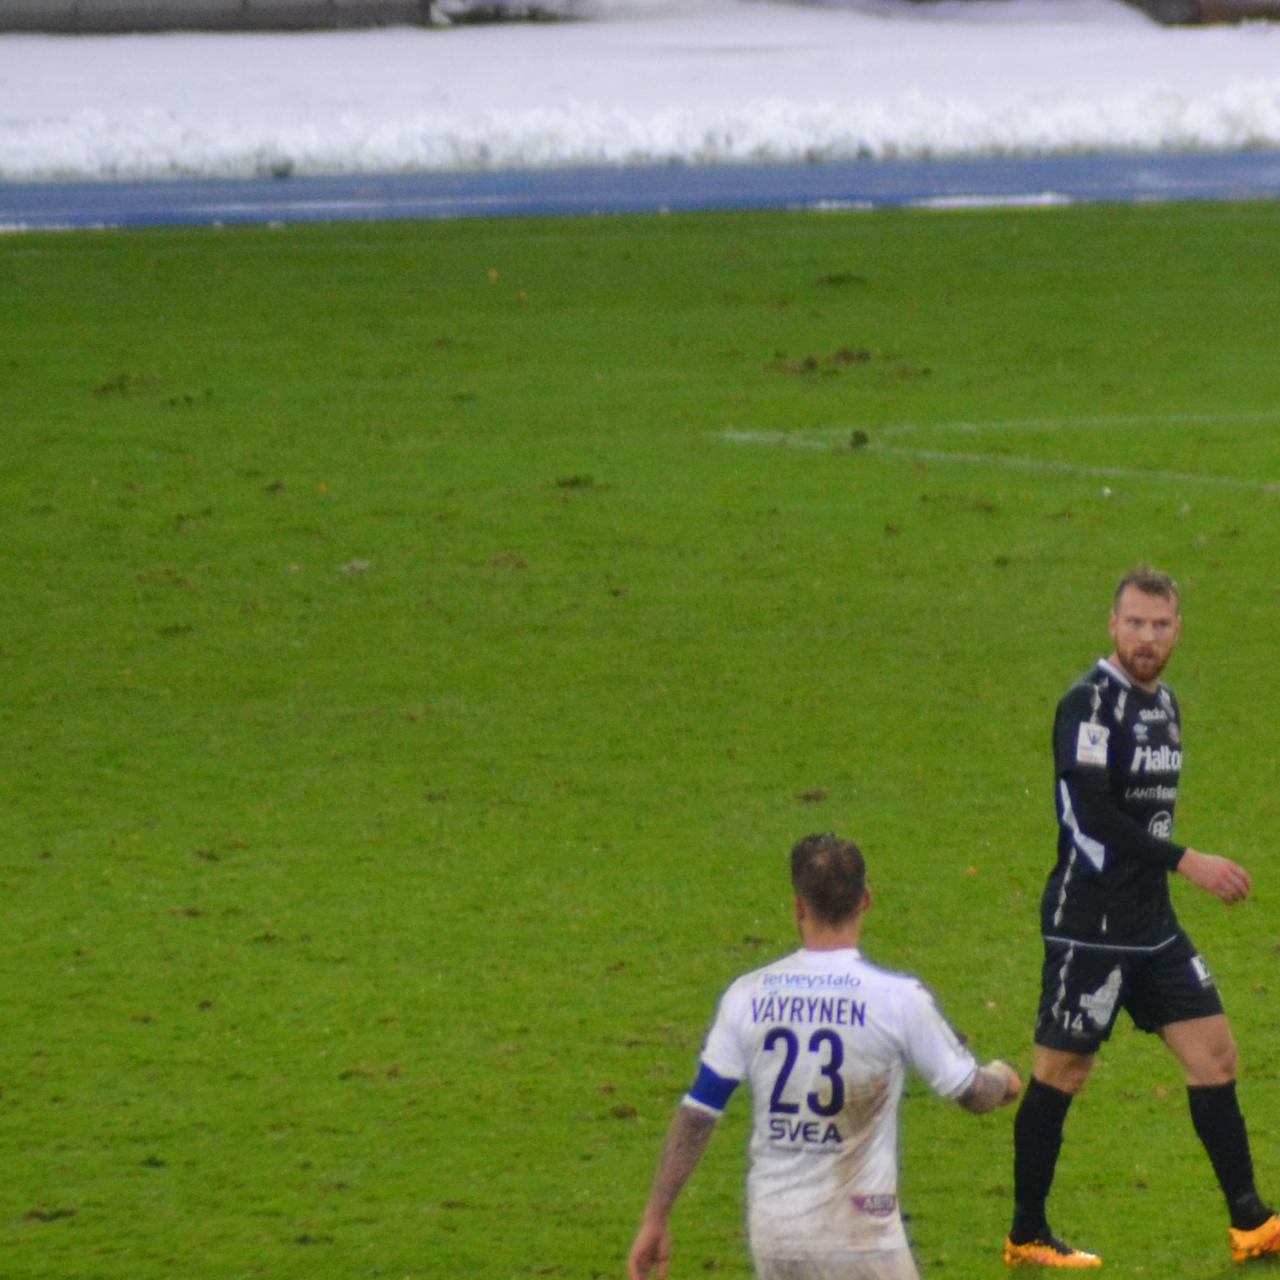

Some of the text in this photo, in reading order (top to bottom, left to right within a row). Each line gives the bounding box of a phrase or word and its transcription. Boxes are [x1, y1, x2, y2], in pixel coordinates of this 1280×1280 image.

[752, 991, 866, 1027] VÄYRYNEN
[1063, 1010, 1083, 1031] 14
[763, 1026, 845, 1116] 23
[769, 1118, 843, 1144] SVEA
